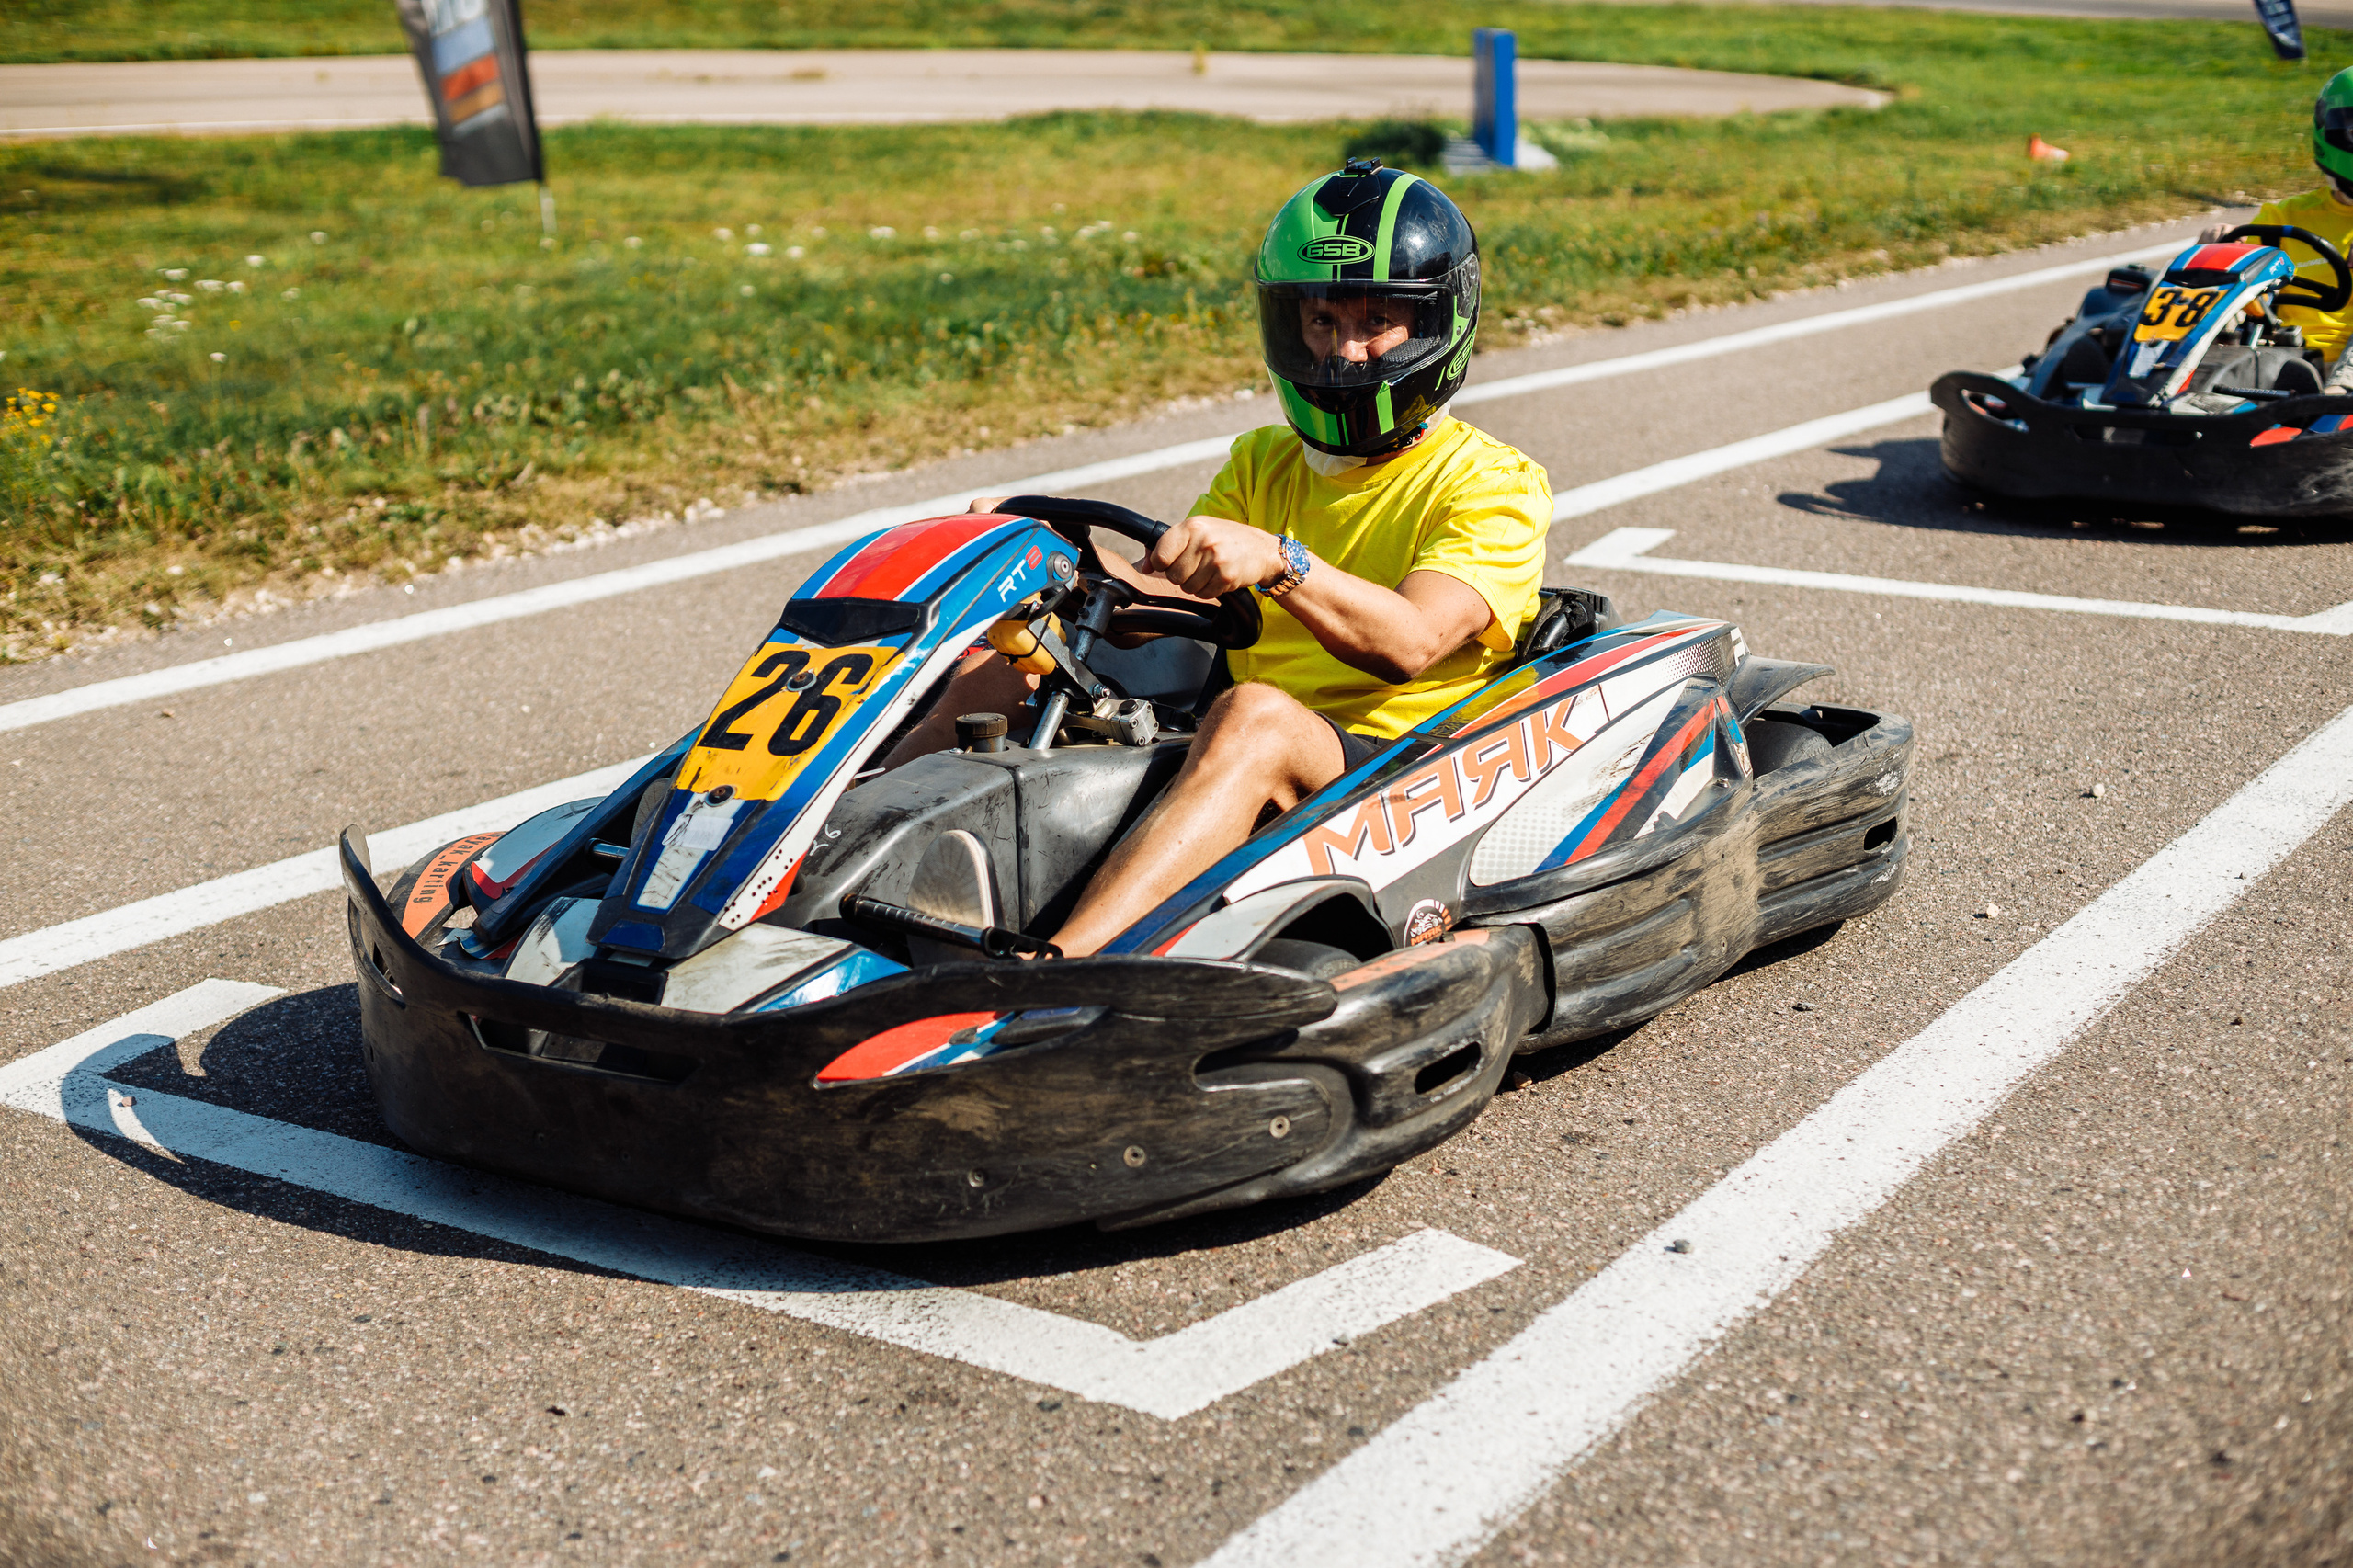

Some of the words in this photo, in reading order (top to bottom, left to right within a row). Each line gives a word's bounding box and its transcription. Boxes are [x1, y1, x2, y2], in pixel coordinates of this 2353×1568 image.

[1306, 243, 1362, 258] GSB
[2139, 288, 2220, 328] 38
[997, 544, 1043, 603] RT8
[696, 649, 874, 757] 26
